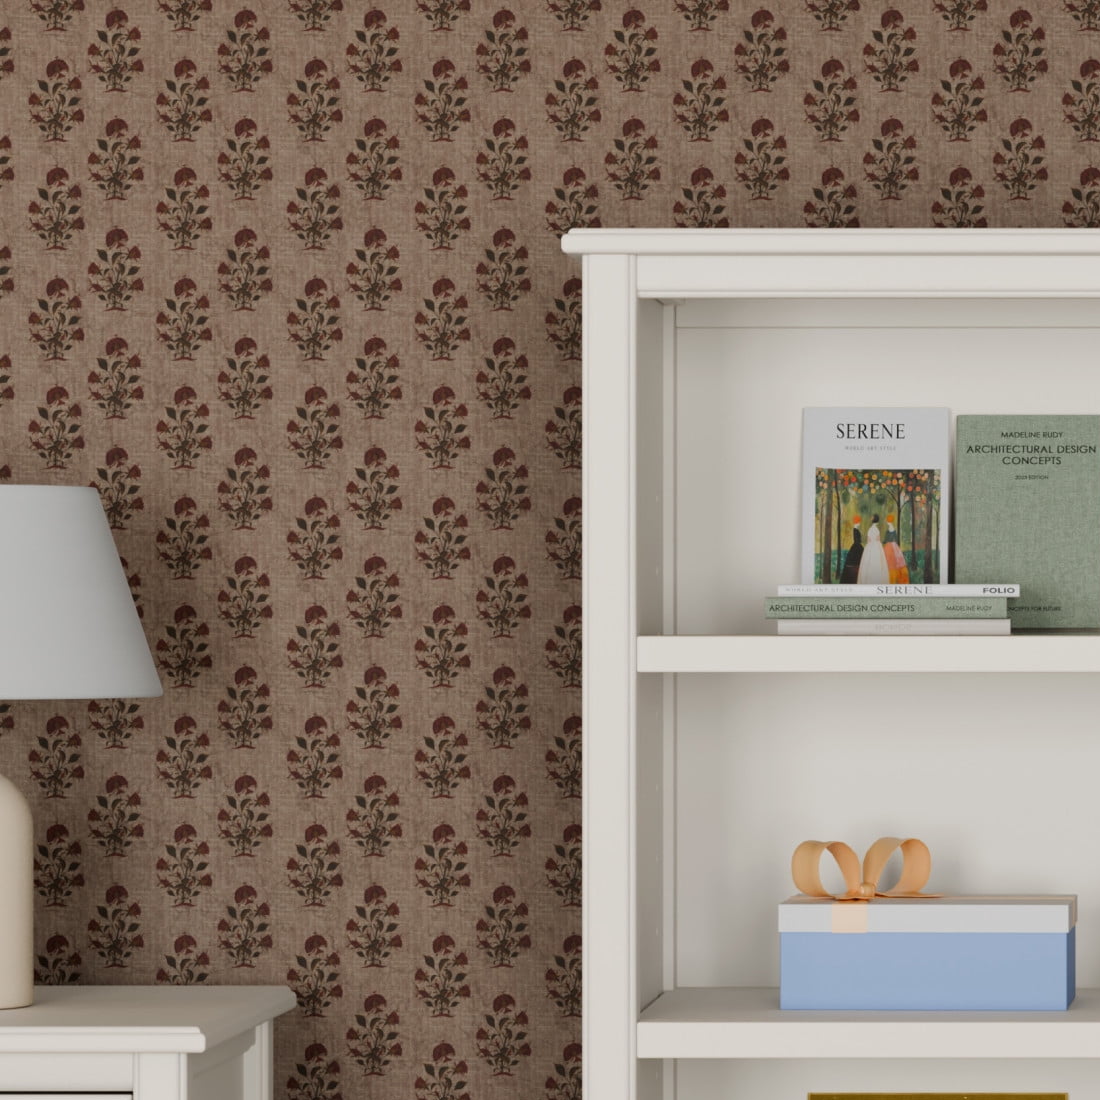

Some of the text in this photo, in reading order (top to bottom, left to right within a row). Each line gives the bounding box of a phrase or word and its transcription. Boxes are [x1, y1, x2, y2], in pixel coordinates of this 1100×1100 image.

[836, 423, 905, 439] SERENE
[966, 445, 1096, 454] ARCHITECTURAL DESIGN
[1002, 456, 1062, 465] CONCEPTS
[877, 586, 933, 594] SERENE
